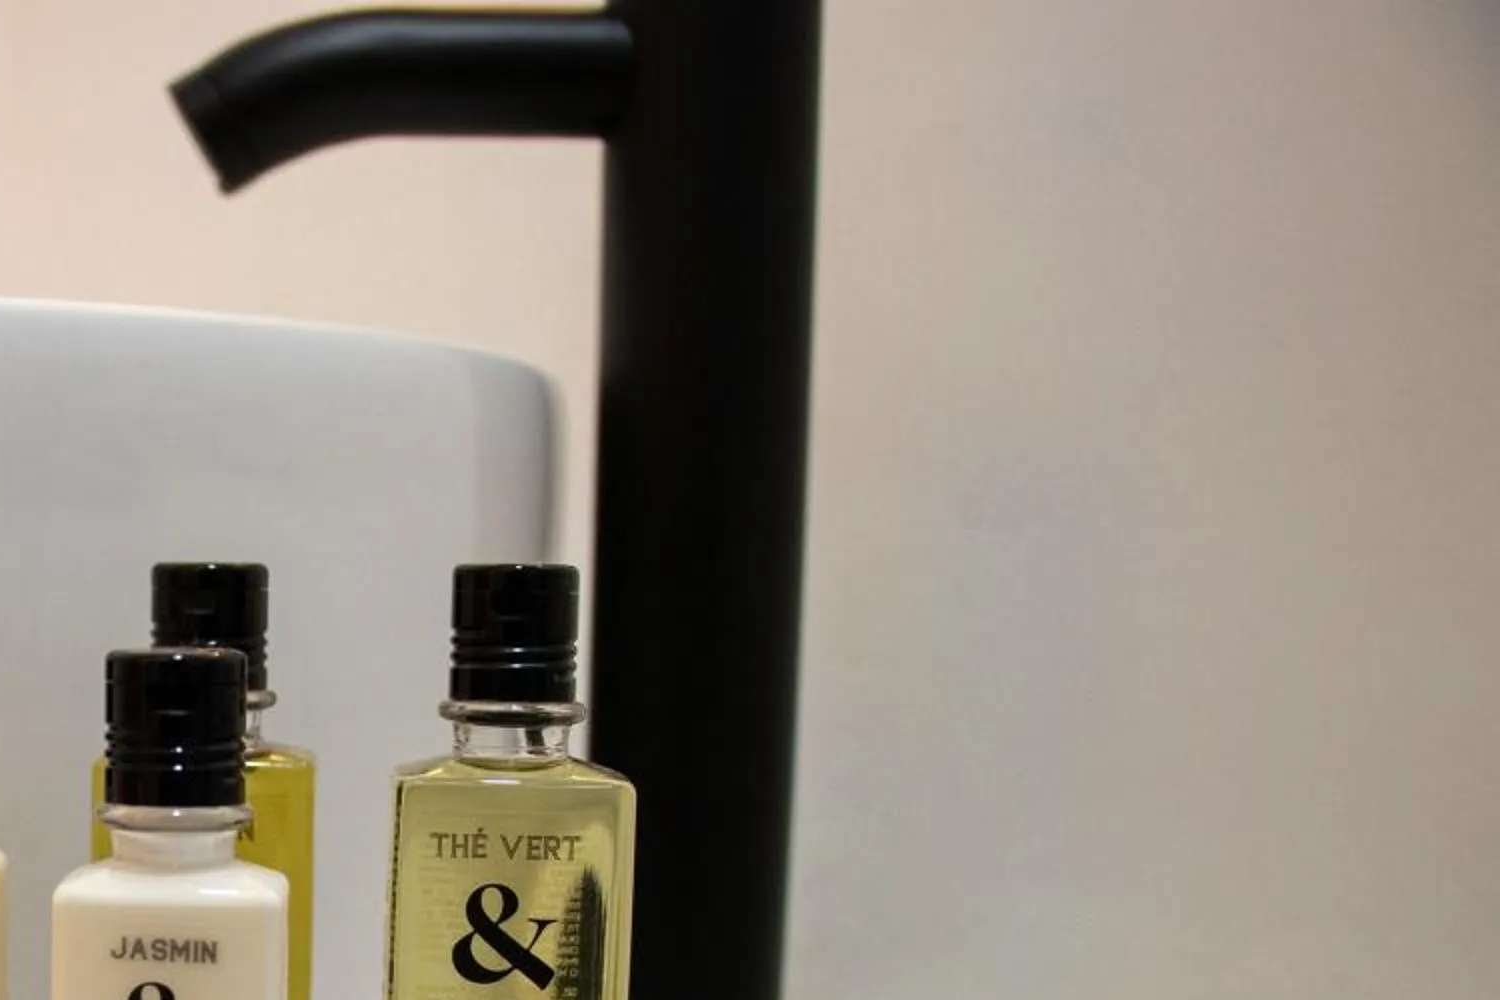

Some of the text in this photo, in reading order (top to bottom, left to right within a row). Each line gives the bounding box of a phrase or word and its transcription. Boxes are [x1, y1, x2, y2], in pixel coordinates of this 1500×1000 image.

[429, 828, 582, 862] THÉ VERT
[110, 936, 218, 964] JASMIN
[452, 883, 558, 991] &
